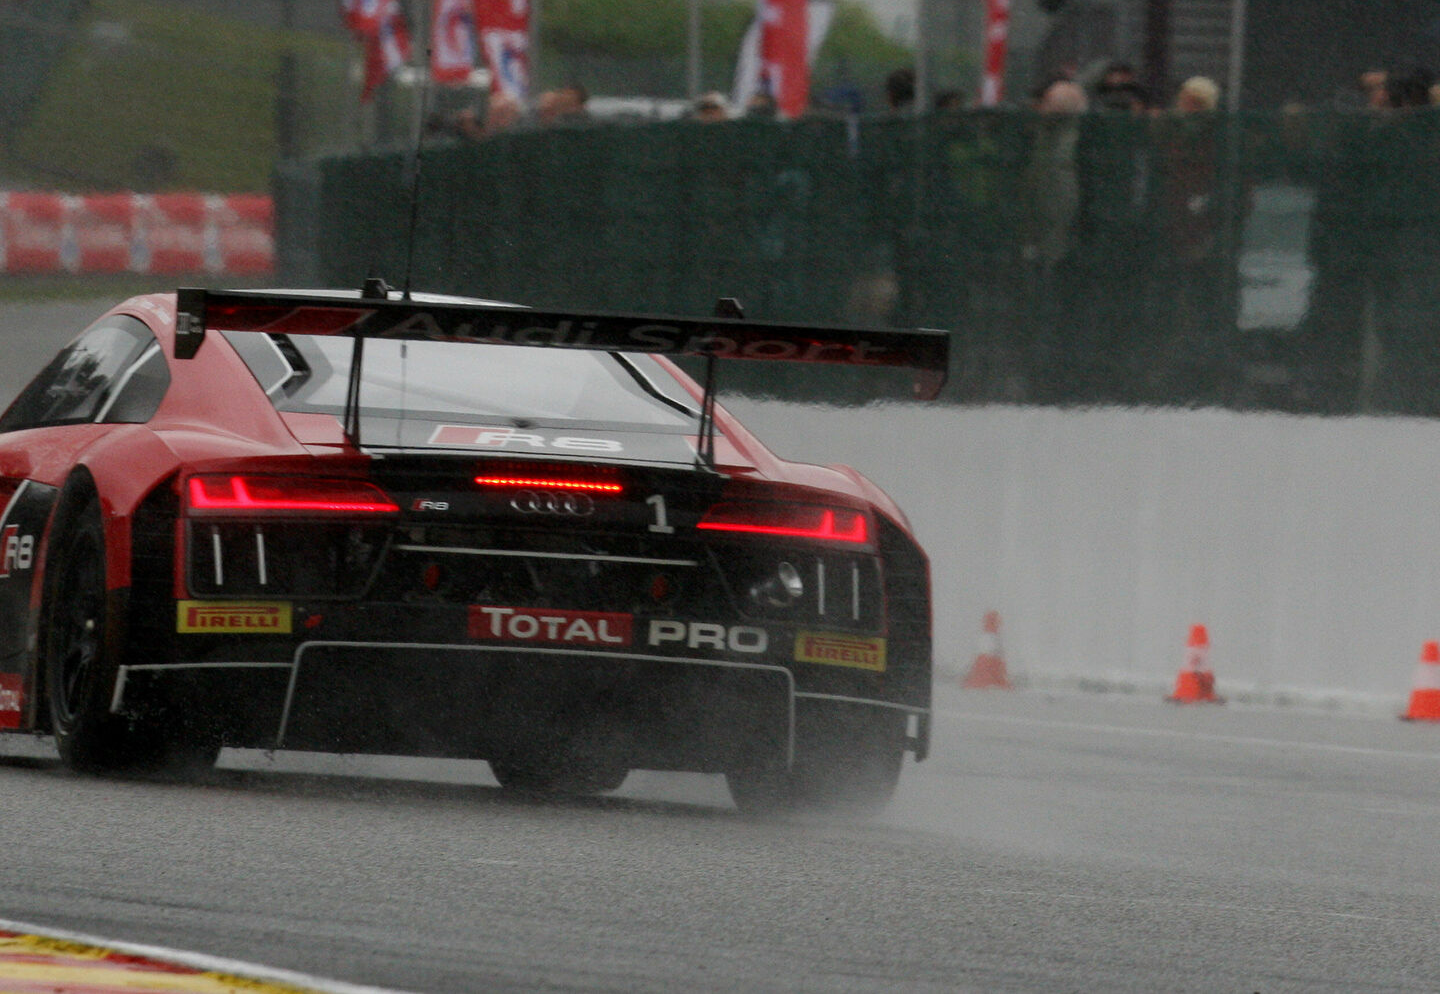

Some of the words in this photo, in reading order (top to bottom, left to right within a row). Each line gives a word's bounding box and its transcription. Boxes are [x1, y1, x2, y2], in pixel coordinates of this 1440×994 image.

[382, 311, 600, 344] Audi
[627, 323, 890, 362] Sport
[472, 430, 624, 452] R8
[418, 500, 450, 511] R8
[646, 494, 675, 534] 1
[3, 534, 35, 570] R8
[187, 606, 280, 628] PIRELLI
[481, 606, 623, 643] TOTAL
[647, 619, 768, 654] PRO
[804, 636, 879, 665] PIRELLI
